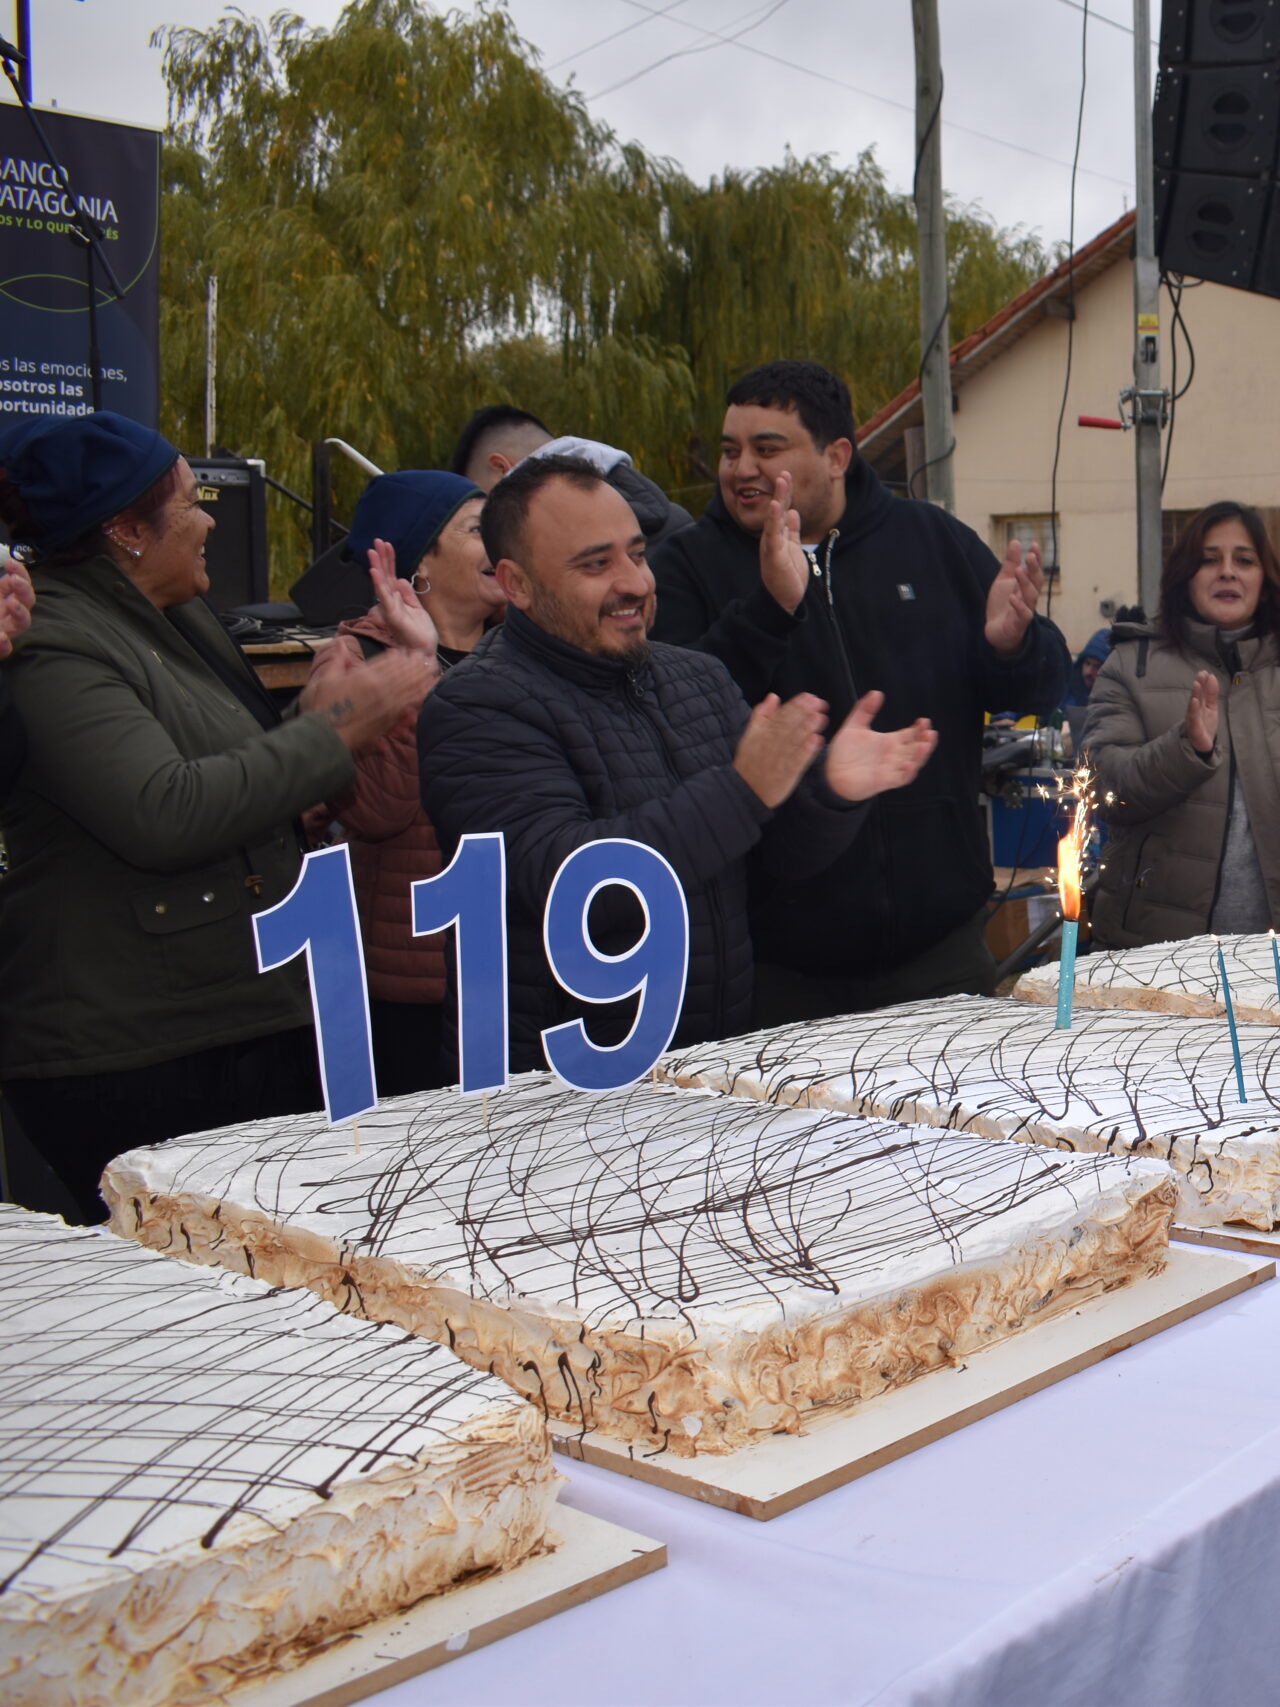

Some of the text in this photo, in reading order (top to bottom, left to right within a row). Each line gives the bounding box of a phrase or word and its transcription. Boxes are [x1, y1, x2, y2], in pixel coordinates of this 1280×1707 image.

[0, 157, 69, 189] ANCO
[0, 184, 119, 224] ATAGONIA
[16, 216, 24, 228] Y
[26, 218, 43, 230] LO
[46, 221, 70, 234] QUE
[0, 359, 10, 371] s
[15, 356, 36, 373] las
[61, 381, 83, 397] las
[0, 399, 95, 417] ortunidade
[251, 831, 690, 1129] 119
